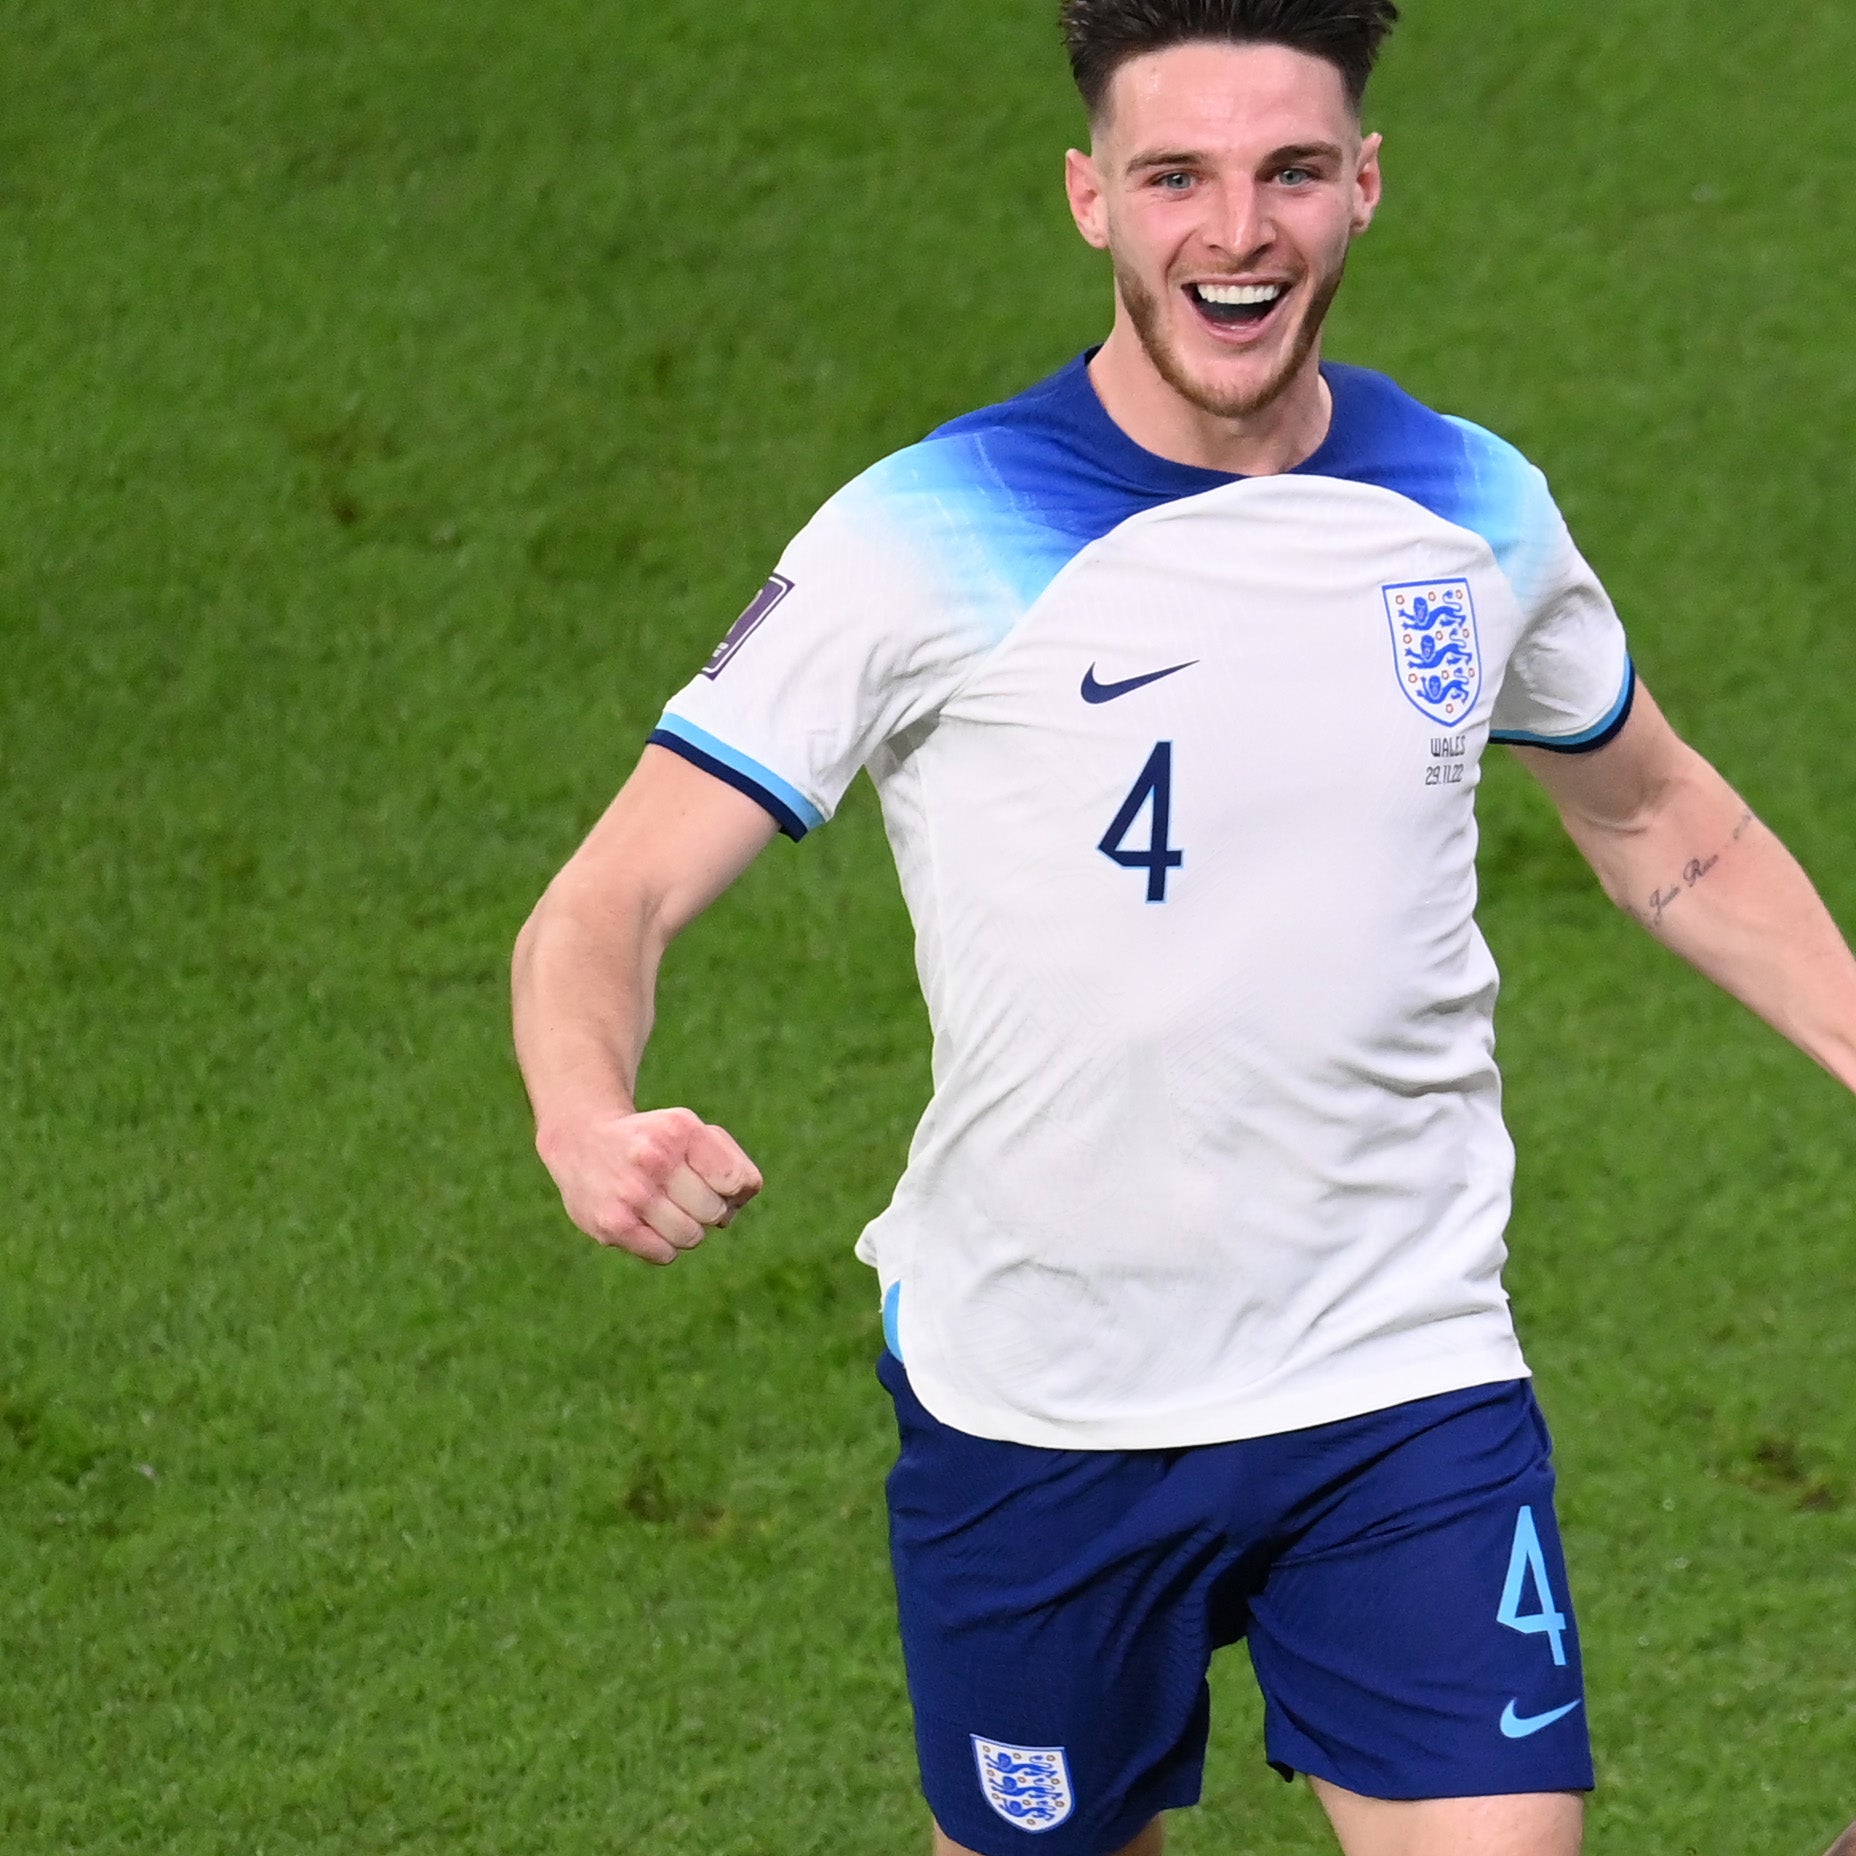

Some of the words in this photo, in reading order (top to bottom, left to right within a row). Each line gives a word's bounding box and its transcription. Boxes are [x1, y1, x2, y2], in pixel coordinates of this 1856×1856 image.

[1097, 740, 1183, 903] 4
[1430, 735, 1466, 757] WALES
[1497, 1505, 1567, 1666] 4
